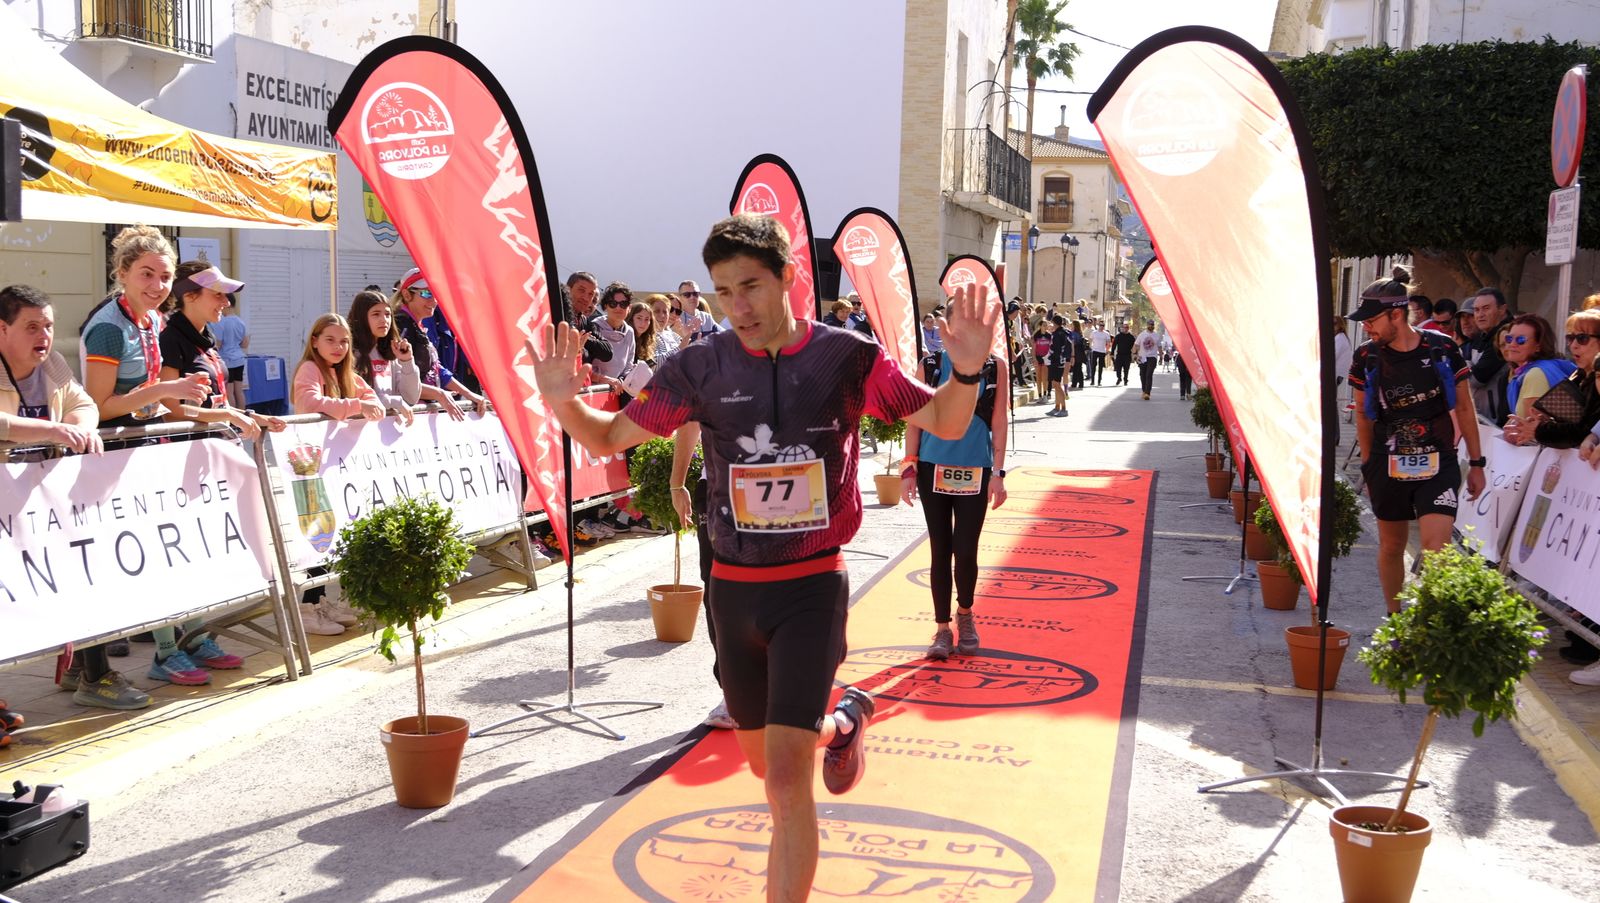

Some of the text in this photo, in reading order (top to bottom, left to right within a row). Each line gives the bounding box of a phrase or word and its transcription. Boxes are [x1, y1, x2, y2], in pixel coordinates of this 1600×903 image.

[338, 440, 501, 474] AYUNTAMIENTO DE
[1398, 456, 1429, 467] 192
[943, 468, 973, 481] 665
[343, 462, 510, 520] CANTORIA
[756, 480, 795, 502] 77
[0, 480, 230, 539] NTAMIENTO DE
[1024, 666, 1064, 674] LA
[863, 745, 1032, 768] Ayuntami
[971, 743, 1015, 754] de
[945, 841, 1005, 859] LA
